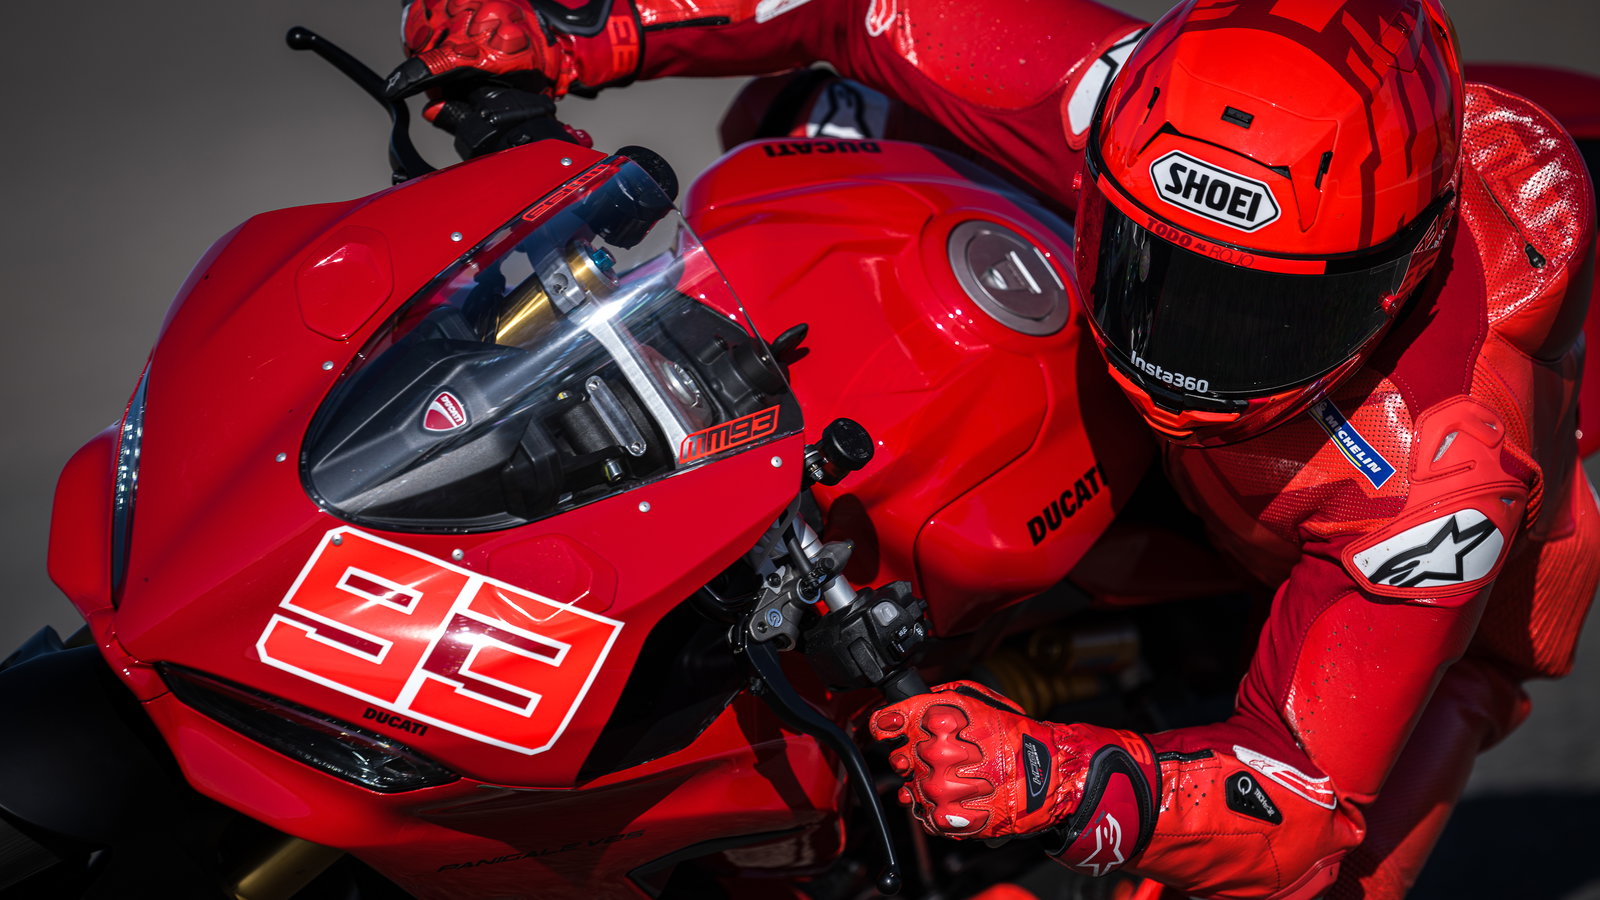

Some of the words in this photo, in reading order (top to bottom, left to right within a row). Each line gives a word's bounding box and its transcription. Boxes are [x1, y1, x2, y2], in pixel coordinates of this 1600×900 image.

[762, 141, 882, 158] DUCATI
[1164, 162, 1263, 222] SHOEI
[1146, 216, 1193, 247] TODO
[1208, 244, 1255, 267] ROJO
[1130, 350, 1209, 393] Insta360
[440, 395, 464, 422] DUCATI
[1325, 414, 1382, 473] MICHELIN
[1026, 461, 1109, 546] DUCATI
[256, 525, 625, 755] 93
[362, 707, 429, 736] DUCATI
